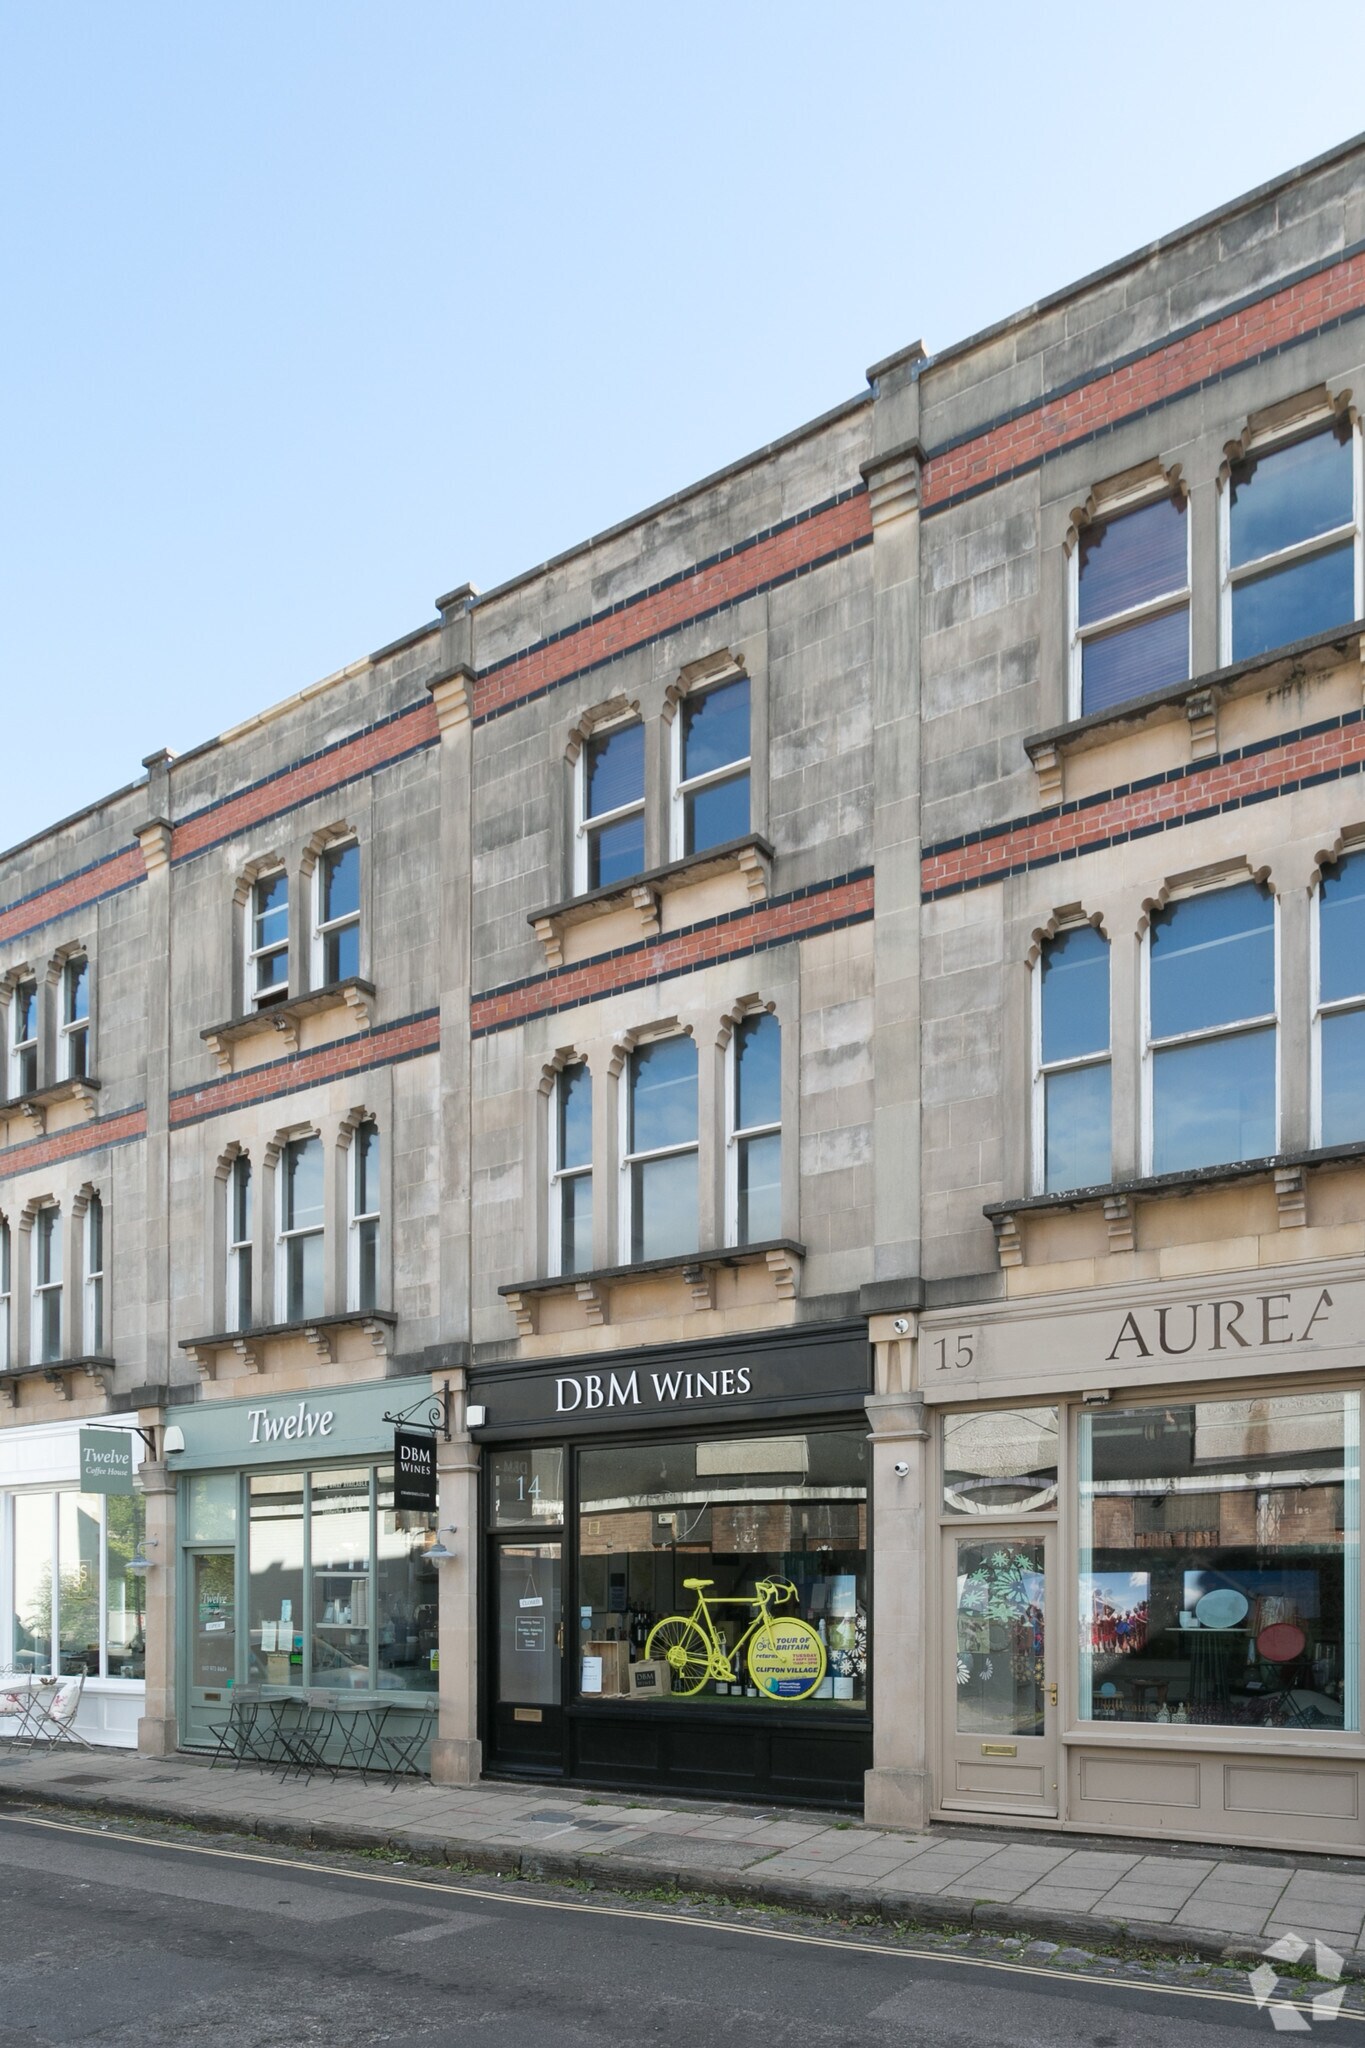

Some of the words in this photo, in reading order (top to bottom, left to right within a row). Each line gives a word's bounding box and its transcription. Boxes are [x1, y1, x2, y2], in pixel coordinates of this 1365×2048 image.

[1105, 1289, 1334, 1361] AUREA
[933, 1334, 974, 1371] 15
[555, 1370, 642, 1412] DBM
[650, 1367, 751, 1402] WINES
[248, 1402, 334, 1443] Twelve
[83, 1447, 129, 1465] Twelve
[400, 1445, 431, 1463] DBM
[85, 1466, 106, 1477] Coffee
[107, 1468, 128, 1476] House
[400, 1461, 431, 1475] WINES
[516, 1474, 542, 1501] 14
[636, 1672, 655, 1682] DBM
[786, 1666, 818, 1674] VILLAGE
